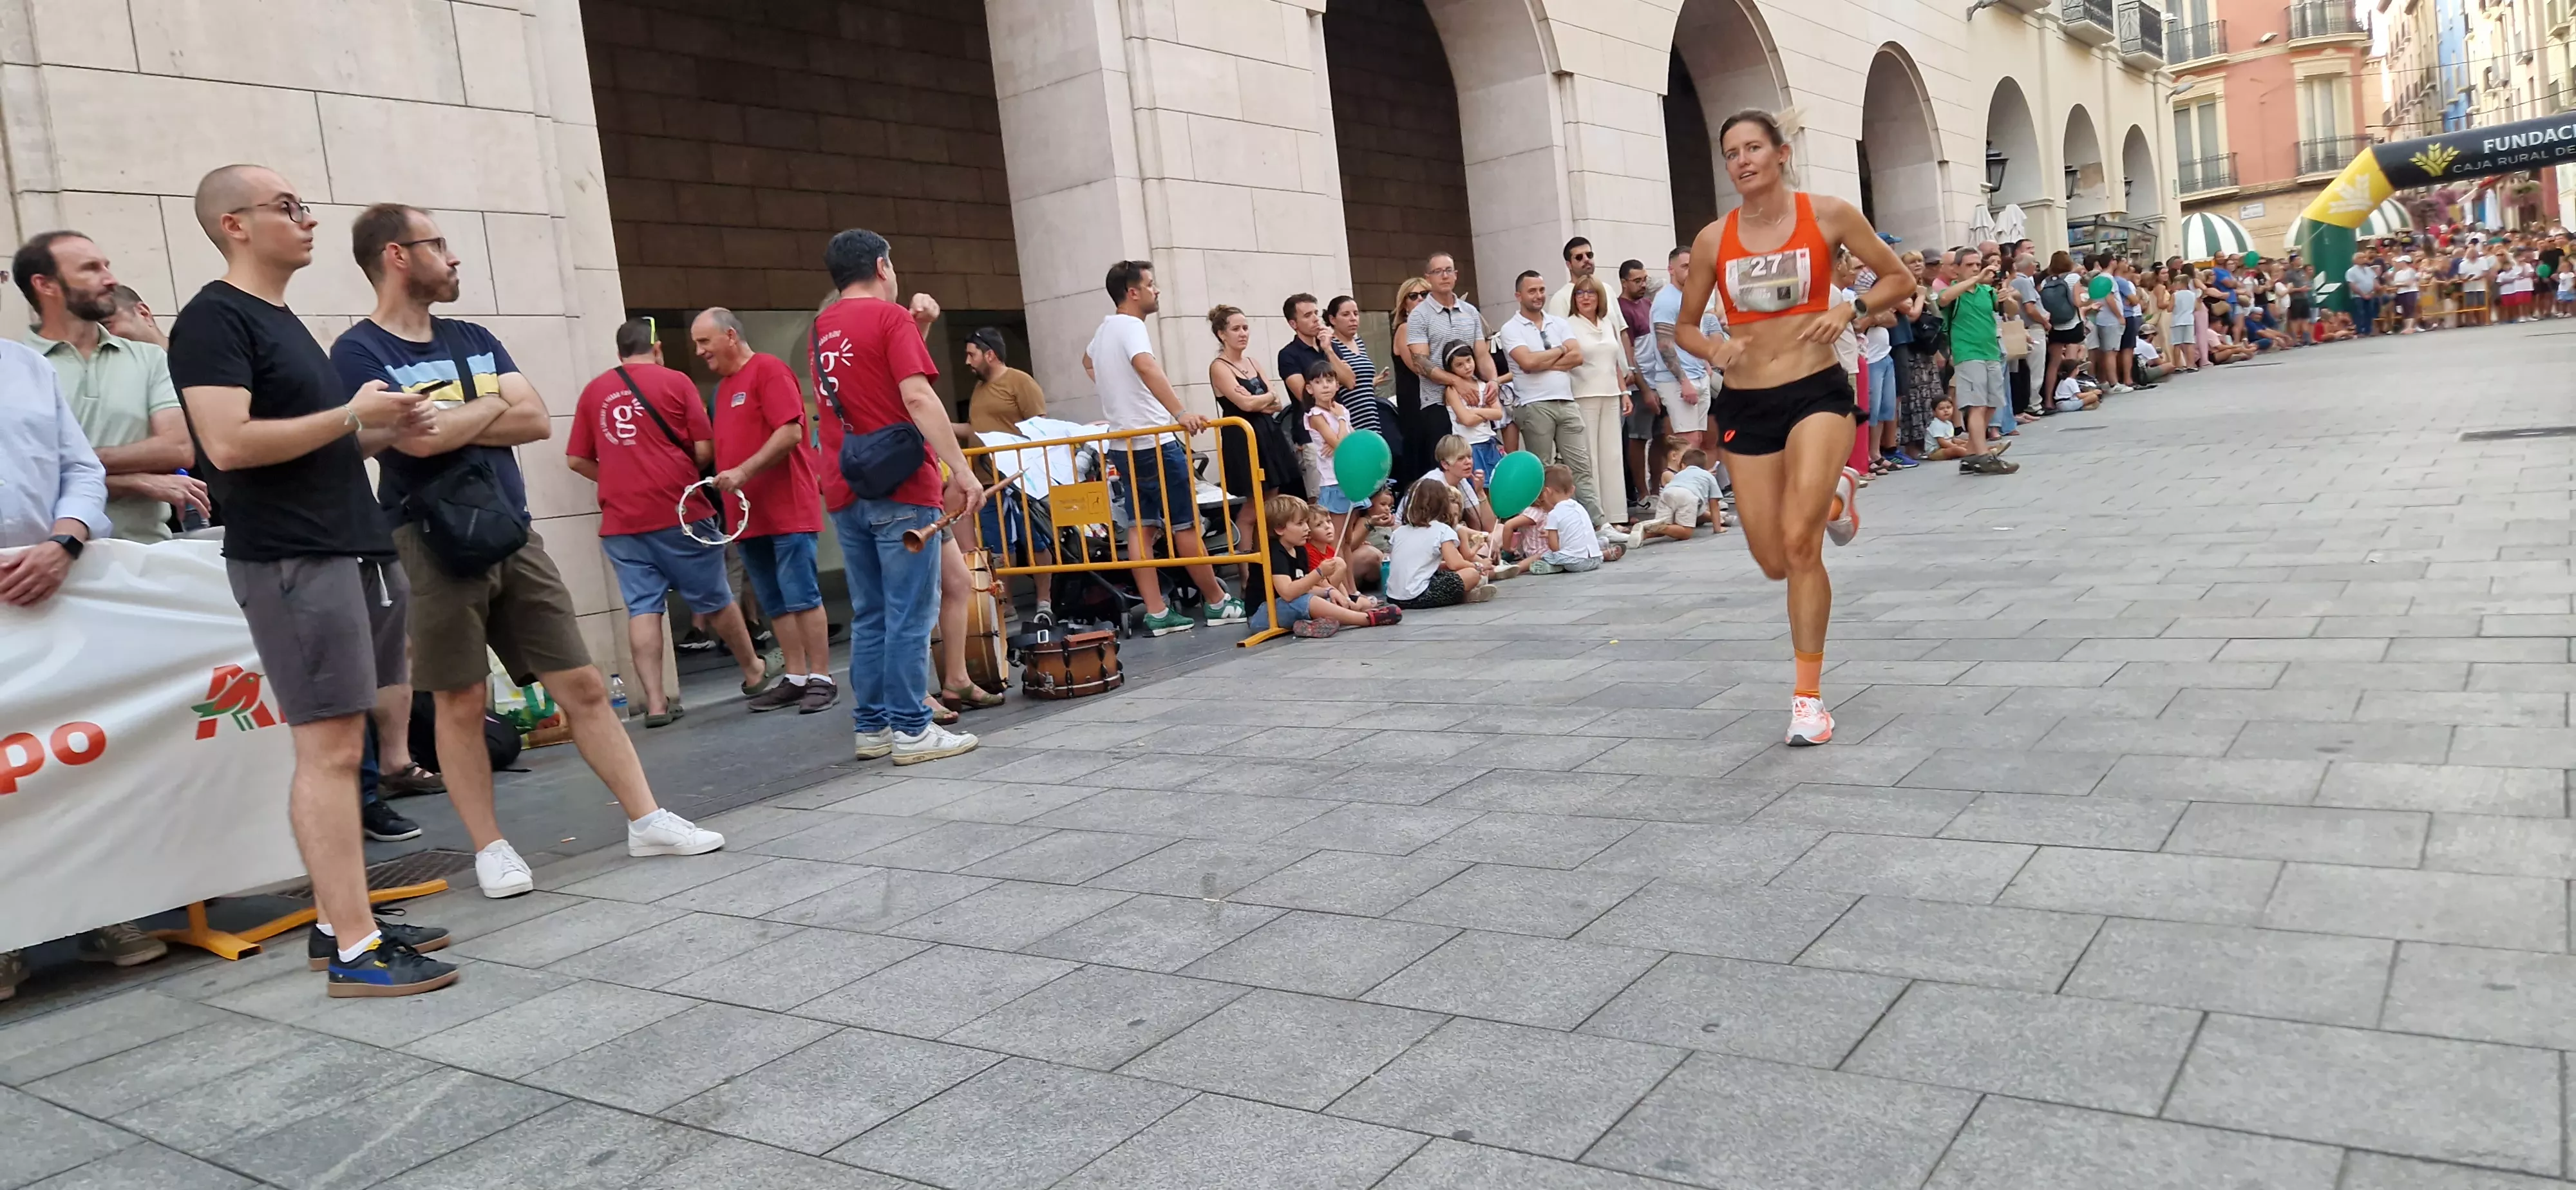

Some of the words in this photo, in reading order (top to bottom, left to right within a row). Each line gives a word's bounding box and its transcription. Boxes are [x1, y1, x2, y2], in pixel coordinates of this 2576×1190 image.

[2452, 161, 2492, 173] CAJA
[2497, 151, 2549, 165] RURAL
[2554, 145, 2576, 156] DE
[1750, 254, 1782, 277] 27
[0, 721, 106, 795] po
